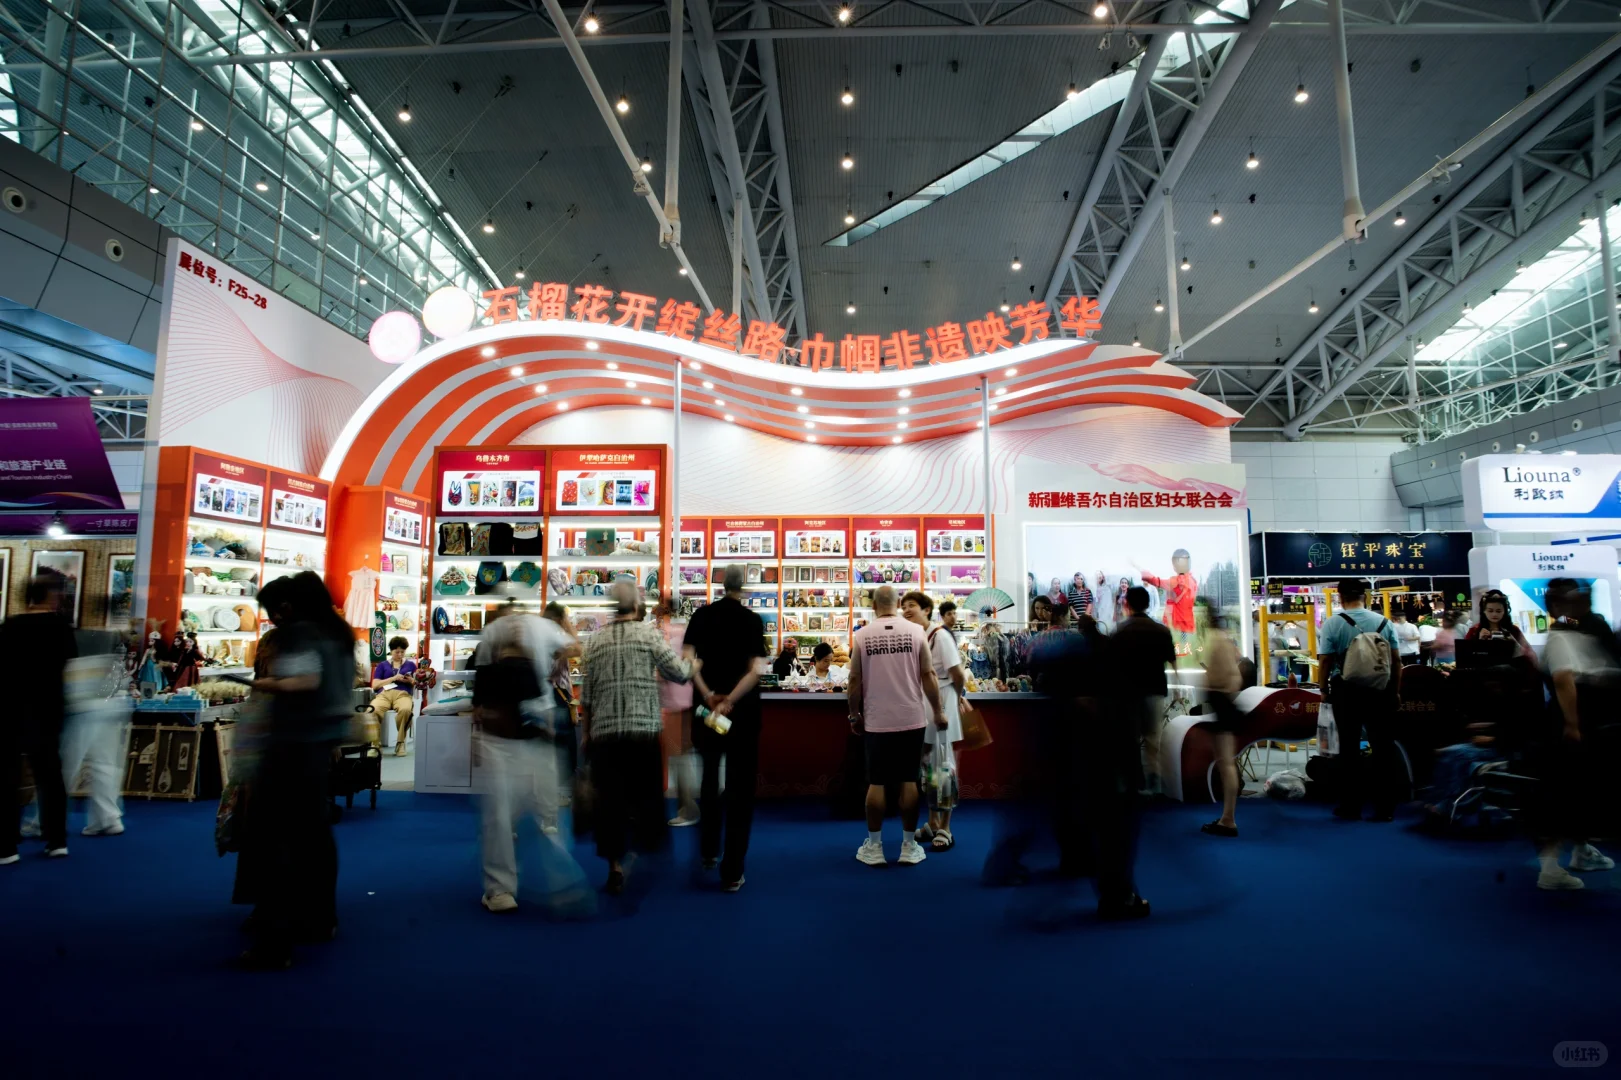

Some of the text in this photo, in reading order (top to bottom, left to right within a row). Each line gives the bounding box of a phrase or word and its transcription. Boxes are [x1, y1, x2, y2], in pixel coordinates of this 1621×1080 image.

[482, 281, 1102, 374] 石榴花开绽丝路 巾帼非遗映芳华
[476, 454, 510, 462] 乌鲁木齐市
[1028, 491, 1233, 508] 新疆维吾尔自治区妇女联合会
[1340, 542, 1424, 558] 钰平珠宝
[866, 646, 912, 656] DAM DAM
